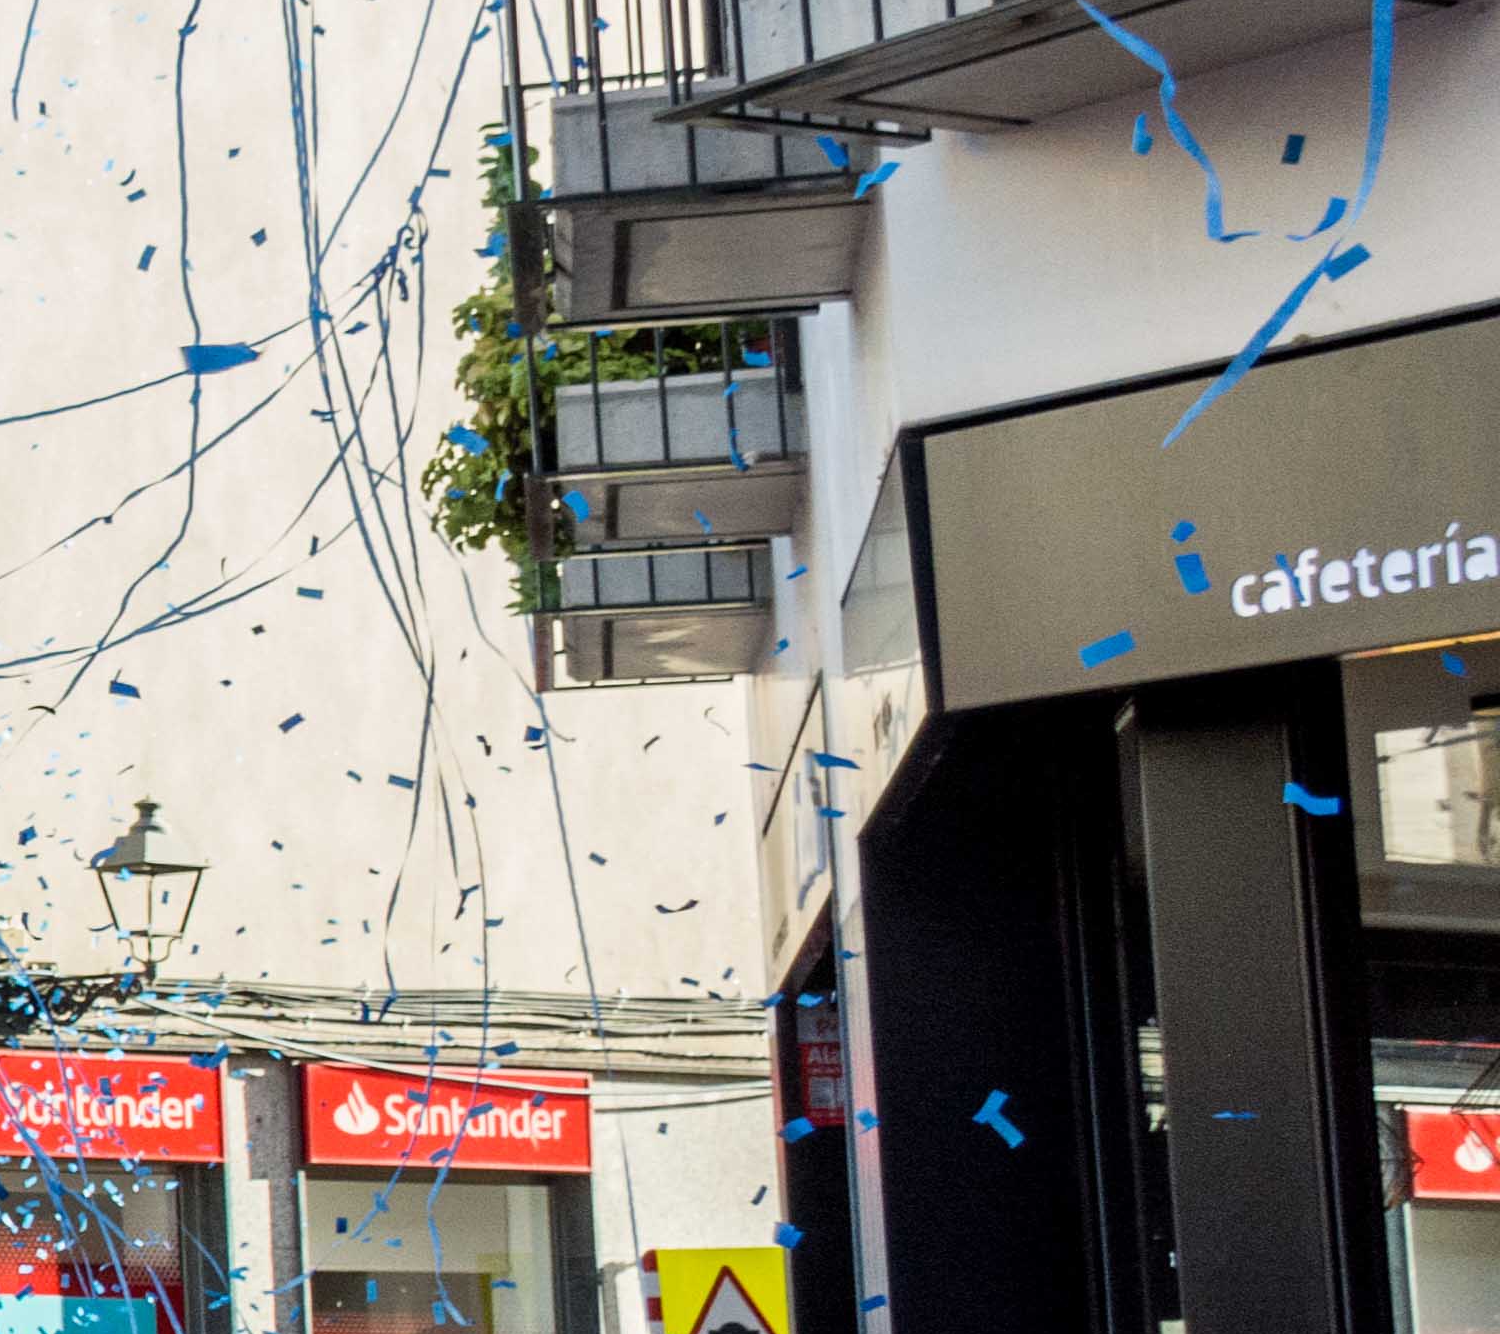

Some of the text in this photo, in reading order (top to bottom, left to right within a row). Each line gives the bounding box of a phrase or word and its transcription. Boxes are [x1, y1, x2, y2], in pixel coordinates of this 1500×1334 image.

[1231, 521, 1500, 618] cafetería
[5, 1081, 199, 1130] Santander
[384, 1093, 567, 1141] Santander
